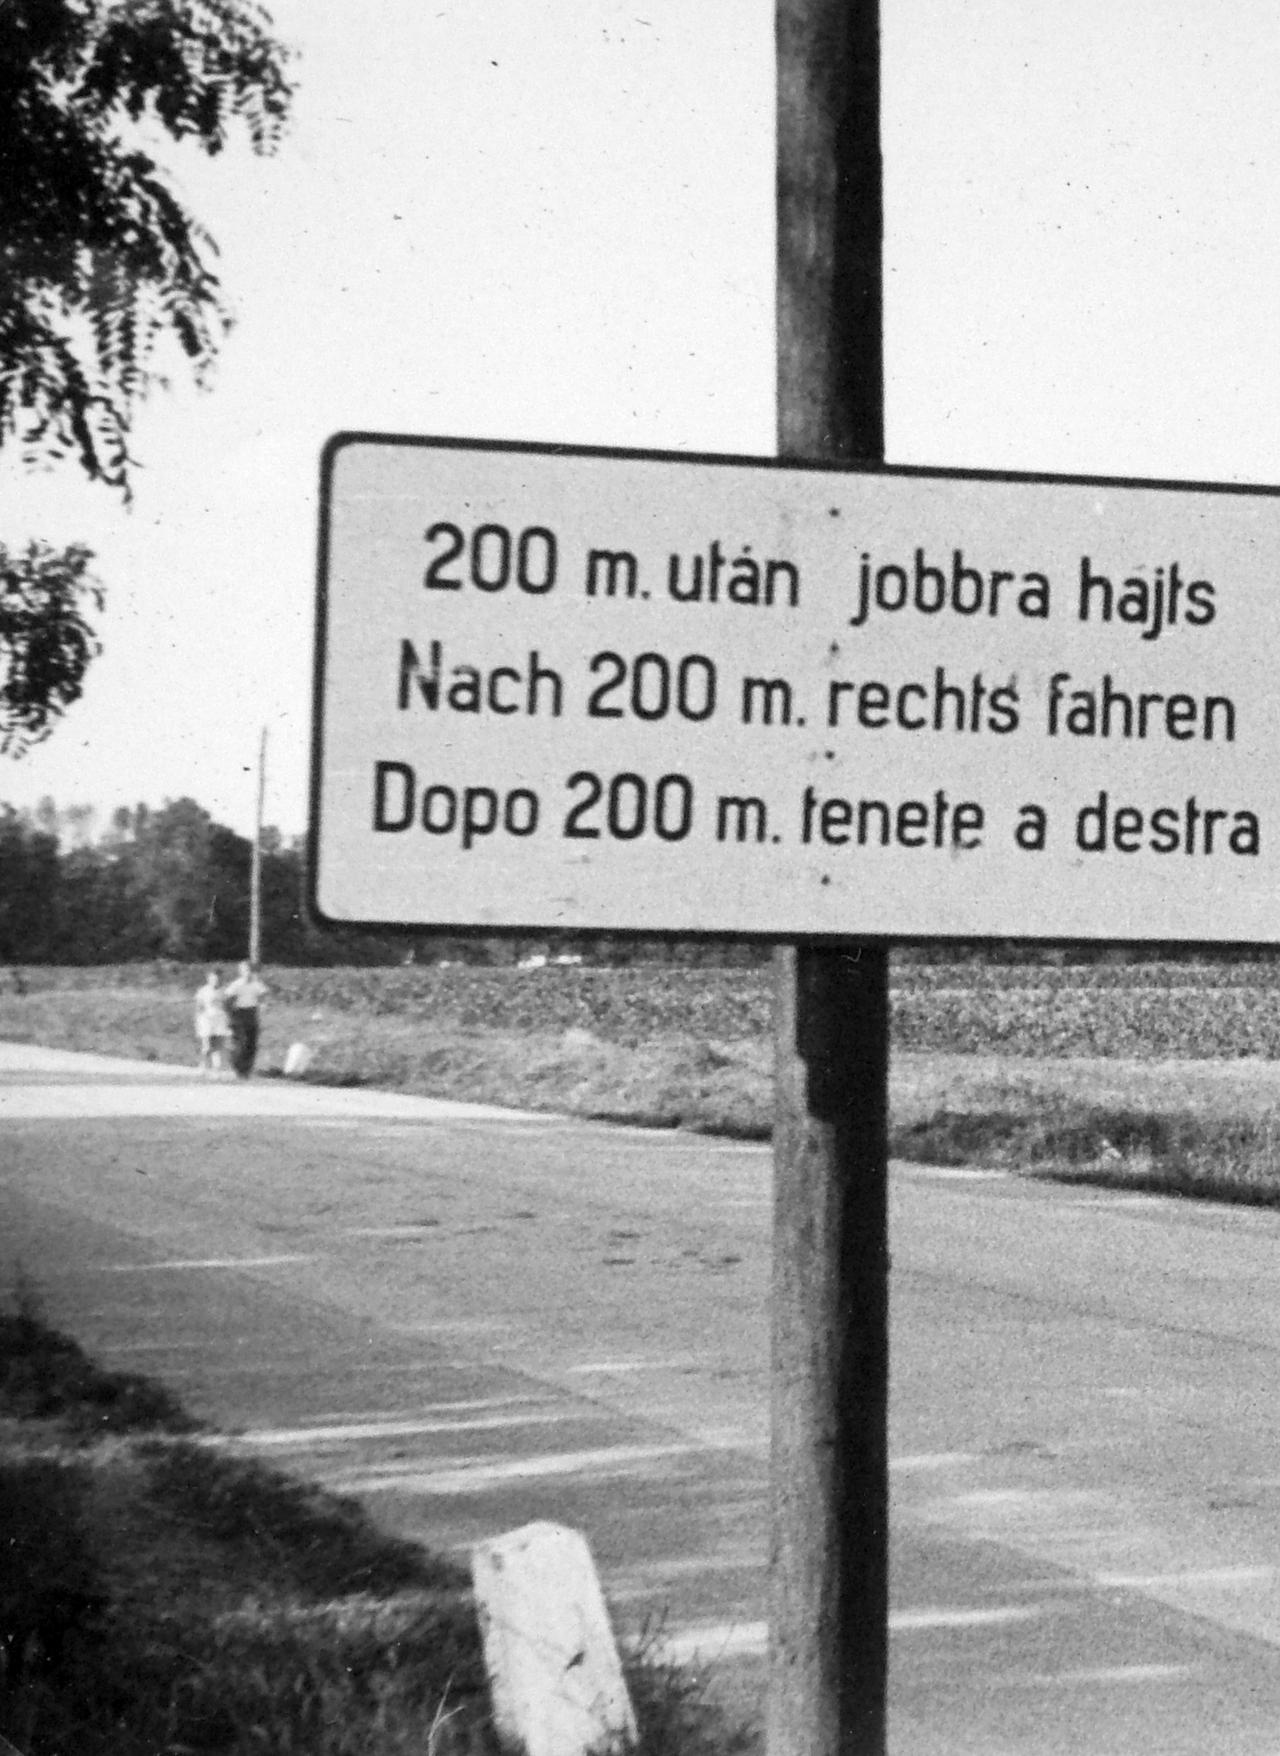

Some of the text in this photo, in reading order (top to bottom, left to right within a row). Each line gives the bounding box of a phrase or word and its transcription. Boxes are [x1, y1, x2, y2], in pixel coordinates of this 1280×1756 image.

[424, 521, 1216, 641] 200 m. után jobbra hajts
[398, 638, 1236, 742] Nach 200 m. rechts fahren
[373, 760, 1260, 857] Dopo 200 m. tenete a destra
